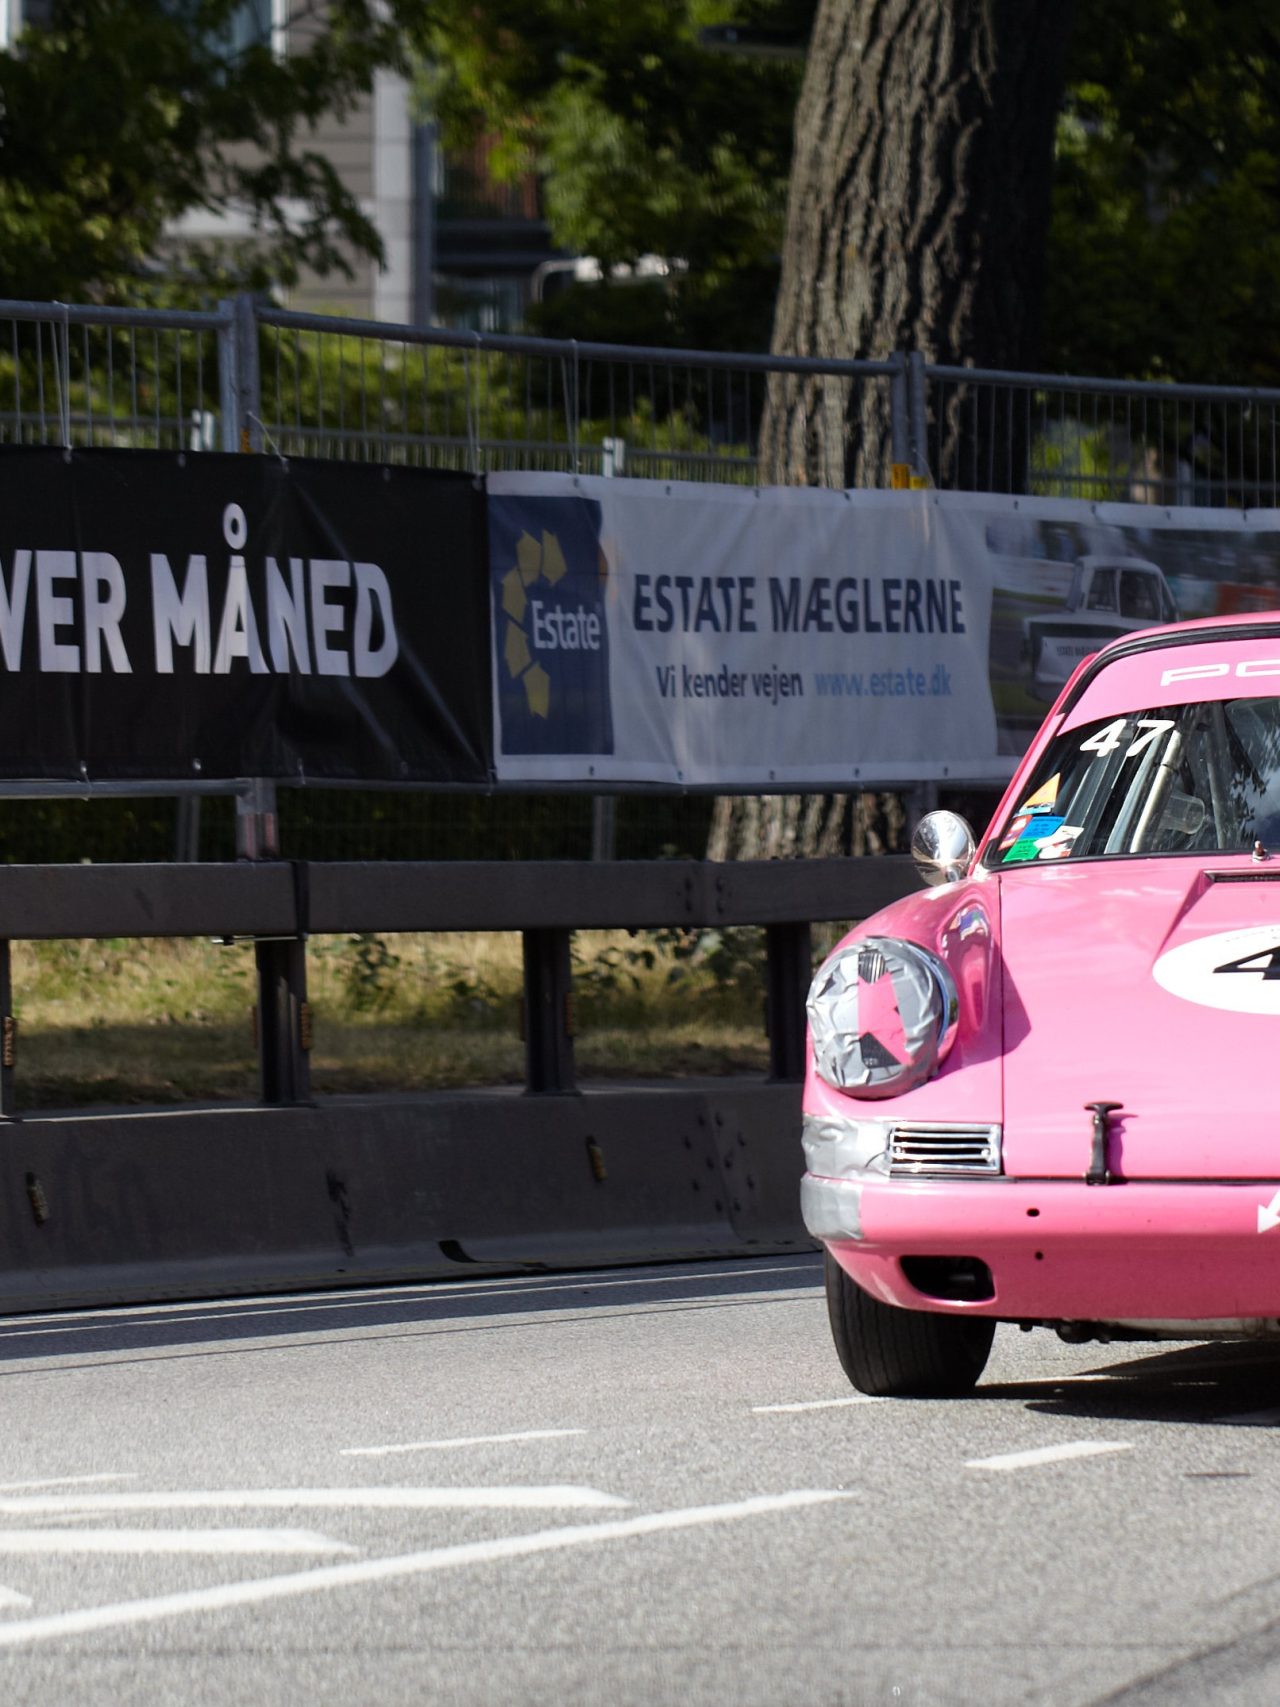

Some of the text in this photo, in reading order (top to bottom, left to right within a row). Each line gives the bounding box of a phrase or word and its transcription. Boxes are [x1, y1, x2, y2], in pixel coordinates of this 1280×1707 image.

[0, 502, 399, 678] VER MÅNED
[633, 573, 966, 634] ESTATE MÆGLERNE
[532, 600, 601, 650] Estate
[656, 664, 953, 706] Vi kender vejen www.estate.dk
[1079, 719, 1176, 758] 47
